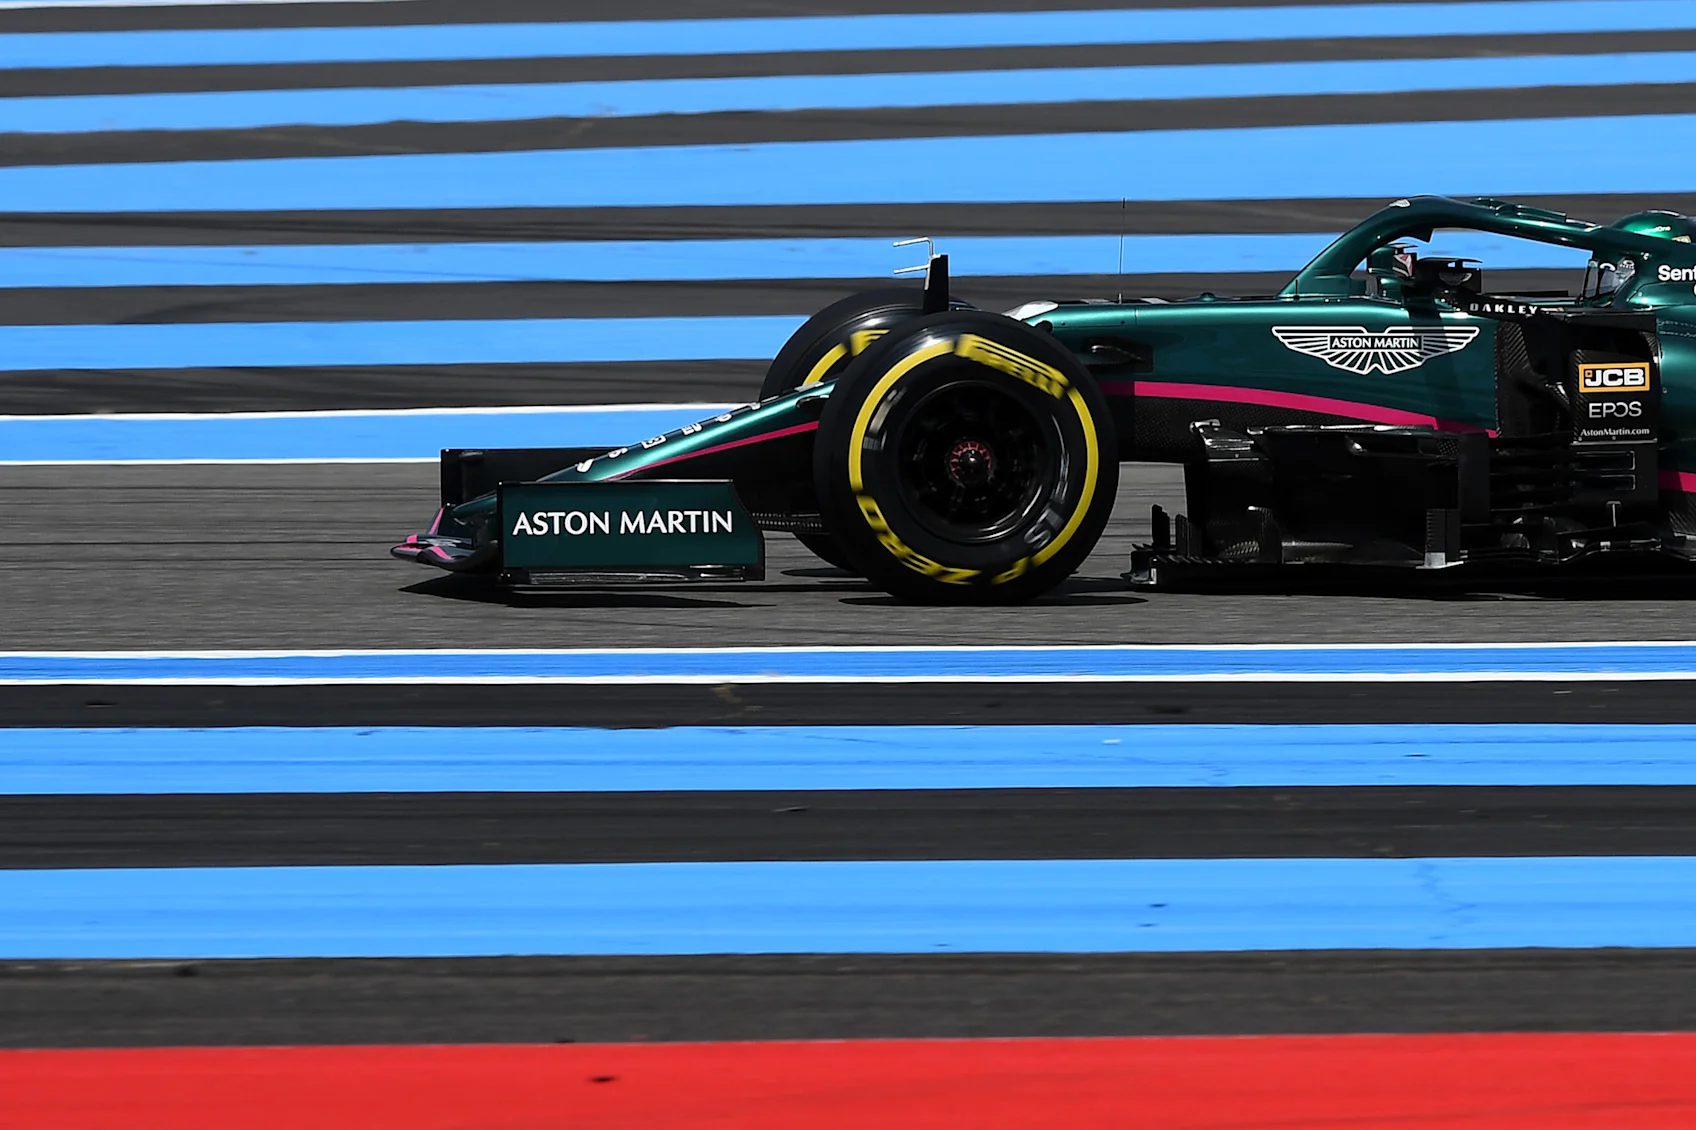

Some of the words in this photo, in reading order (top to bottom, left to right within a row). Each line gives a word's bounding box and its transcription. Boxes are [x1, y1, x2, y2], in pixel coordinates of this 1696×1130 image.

[1469, 303, 1538, 314] OAKLEY
[1331, 337, 1371, 348] ASTON
[1374, 337, 1419, 348] MARTIN
[1585, 368, 1644, 386] JCB
[1588, 401, 1642, 418] EPOS
[1580, 427, 1650, 436] AstonMartin.com
[512, 511, 610, 535] ASTON
[620, 510, 733, 534] MARTIN
